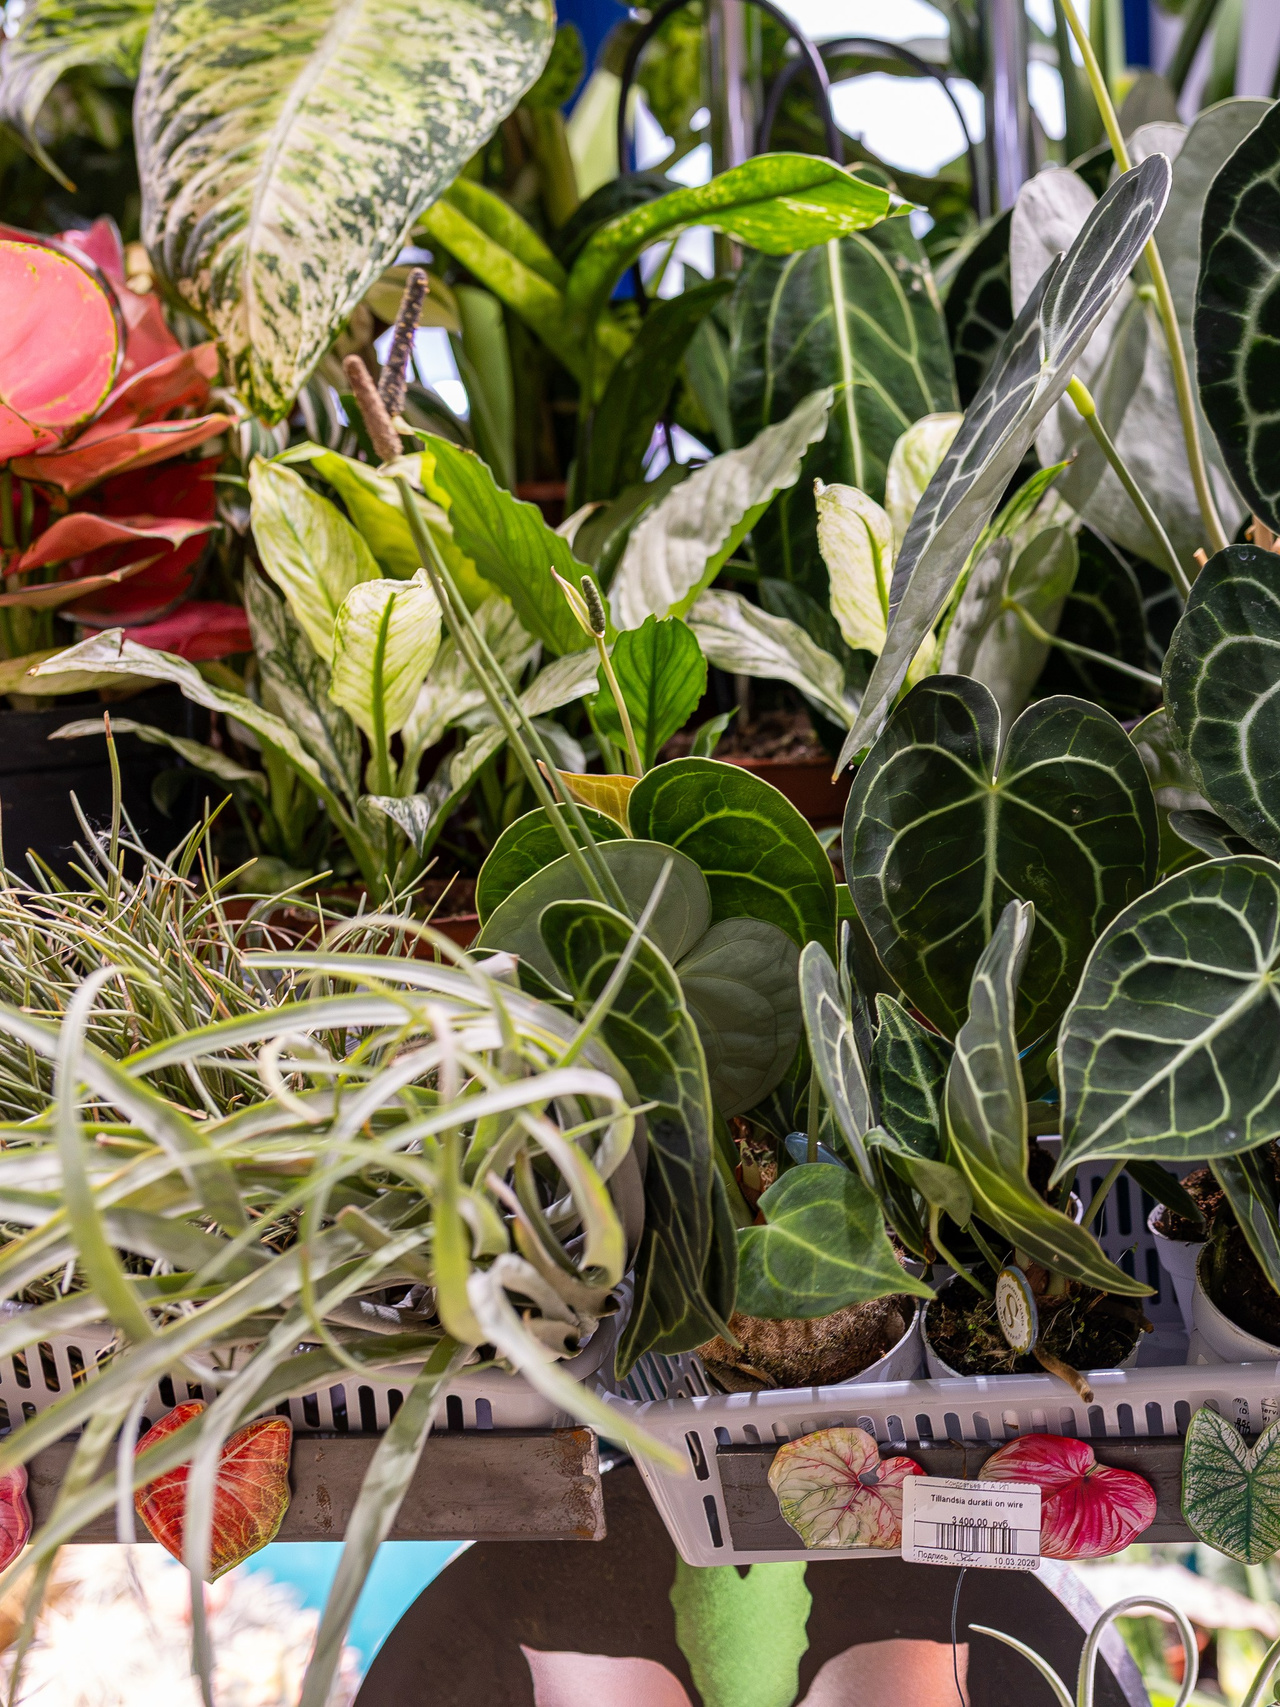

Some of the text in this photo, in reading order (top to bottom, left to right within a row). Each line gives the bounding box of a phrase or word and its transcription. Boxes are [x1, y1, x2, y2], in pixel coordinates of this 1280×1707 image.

[1003, 1293, 1018, 1328] S
[931, 1494, 966, 1505] Tillandsia
[967, 1497, 993, 1507] duratii
[1006, 1500, 1024, 1509] wire
[951, 1516, 957, 1525] 3
[917, 1550, 949, 1561] Подпись
[994, 1557, 1036, 1567] 10.03.2026
